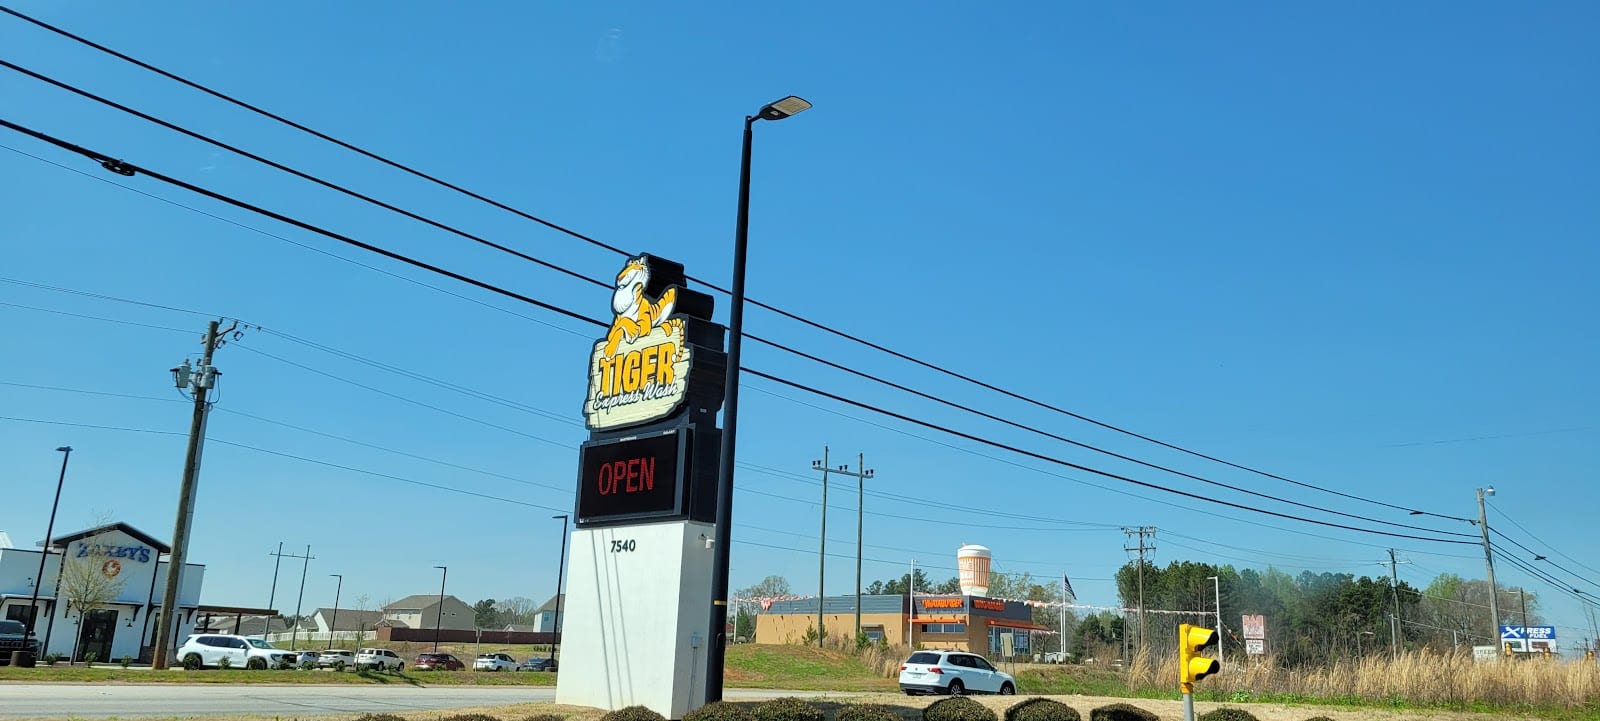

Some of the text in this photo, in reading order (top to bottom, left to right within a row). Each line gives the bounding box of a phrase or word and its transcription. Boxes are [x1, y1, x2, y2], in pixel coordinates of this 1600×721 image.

[599, 341, 677, 398] TIGER
[593, 378, 679, 415] Express Wash
[597, 455, 656, 496] OPEN
[610, 539, 636, 553] 7540
